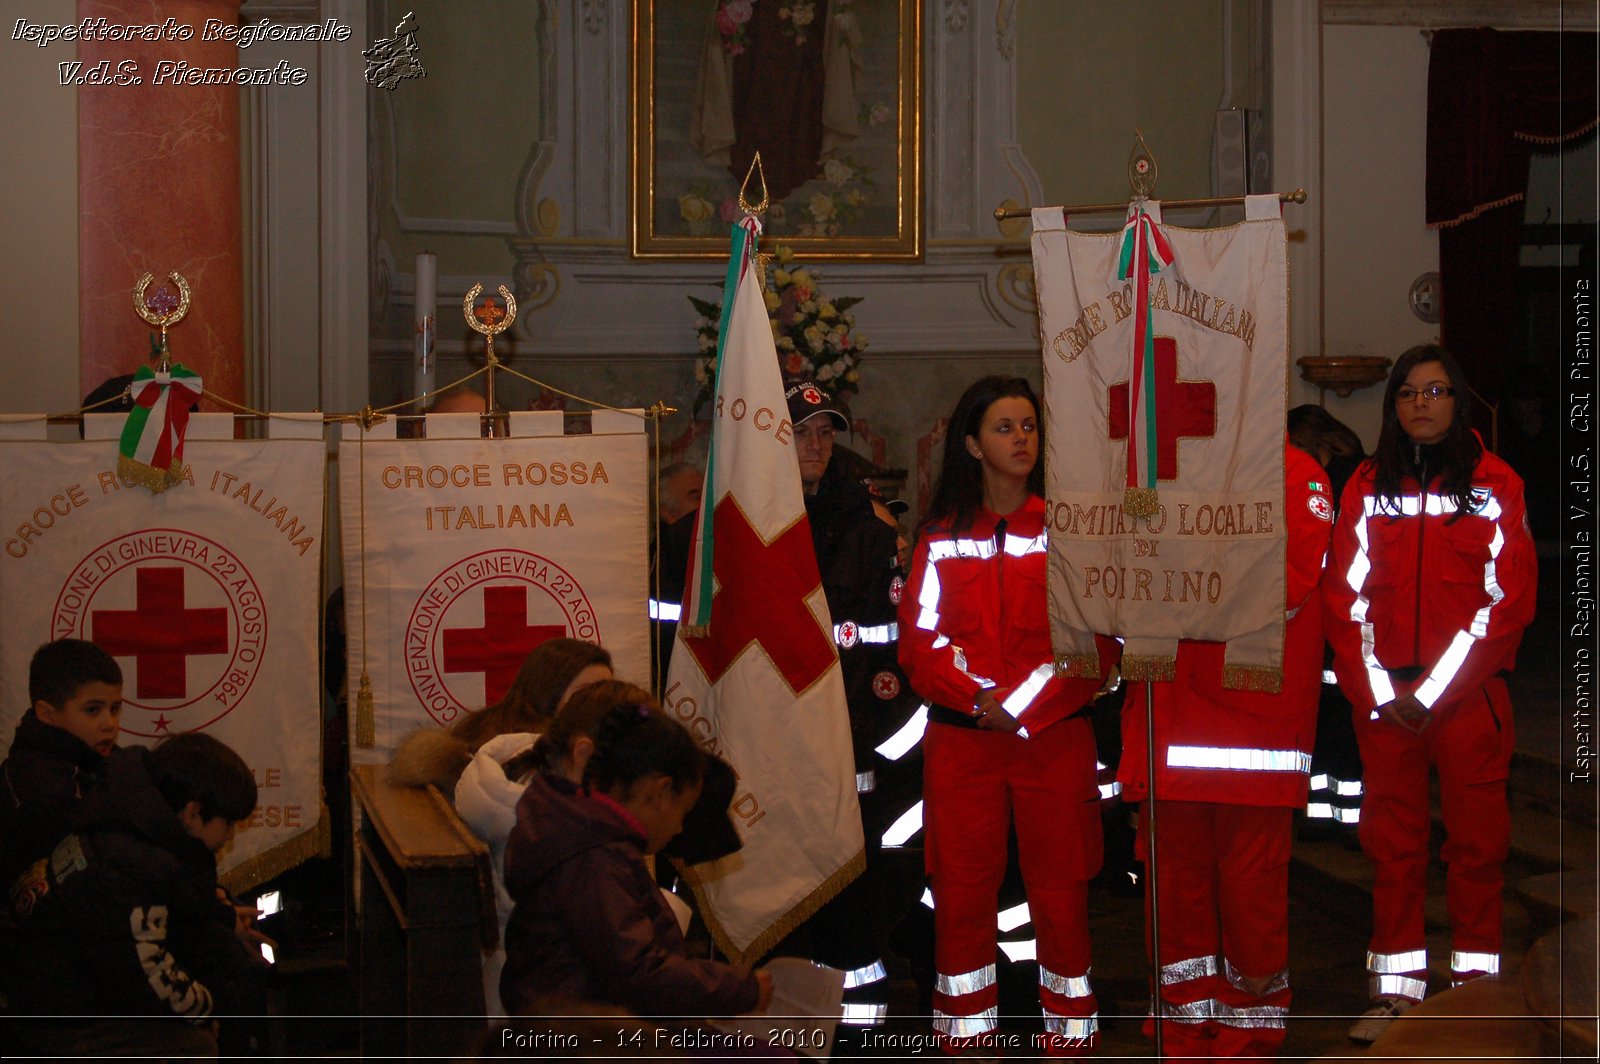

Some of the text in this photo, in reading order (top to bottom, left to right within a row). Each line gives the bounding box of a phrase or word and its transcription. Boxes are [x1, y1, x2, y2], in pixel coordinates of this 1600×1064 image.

[1053, 302, 1107, 363] CROCE
[716, 395, 792, 445] ROCE
[381, 462, 609, 489] CROCE ROSSA
[5, 470, 314, 559] CROCE ITALIANA
[425, 503, 574, 530] ITALIANA
[1177, 501, 1274, 536] LOCALE
[94, 550, 117, 573] DI
[119, 536, 208, 563] GINEVRA
[1134, 539, 1160, 557] DI
[211, 555, 237, 580] 22
[1083, 565, 1222, 604] POIRINO
[230, 579, 262, 663] AGOSTO
[410, 556, 595, 722] CONVENZIONE DI GINEVRA 22 AGO
[214, 668, 249, 706] 1864
[733, 793, 766, 828] DI
